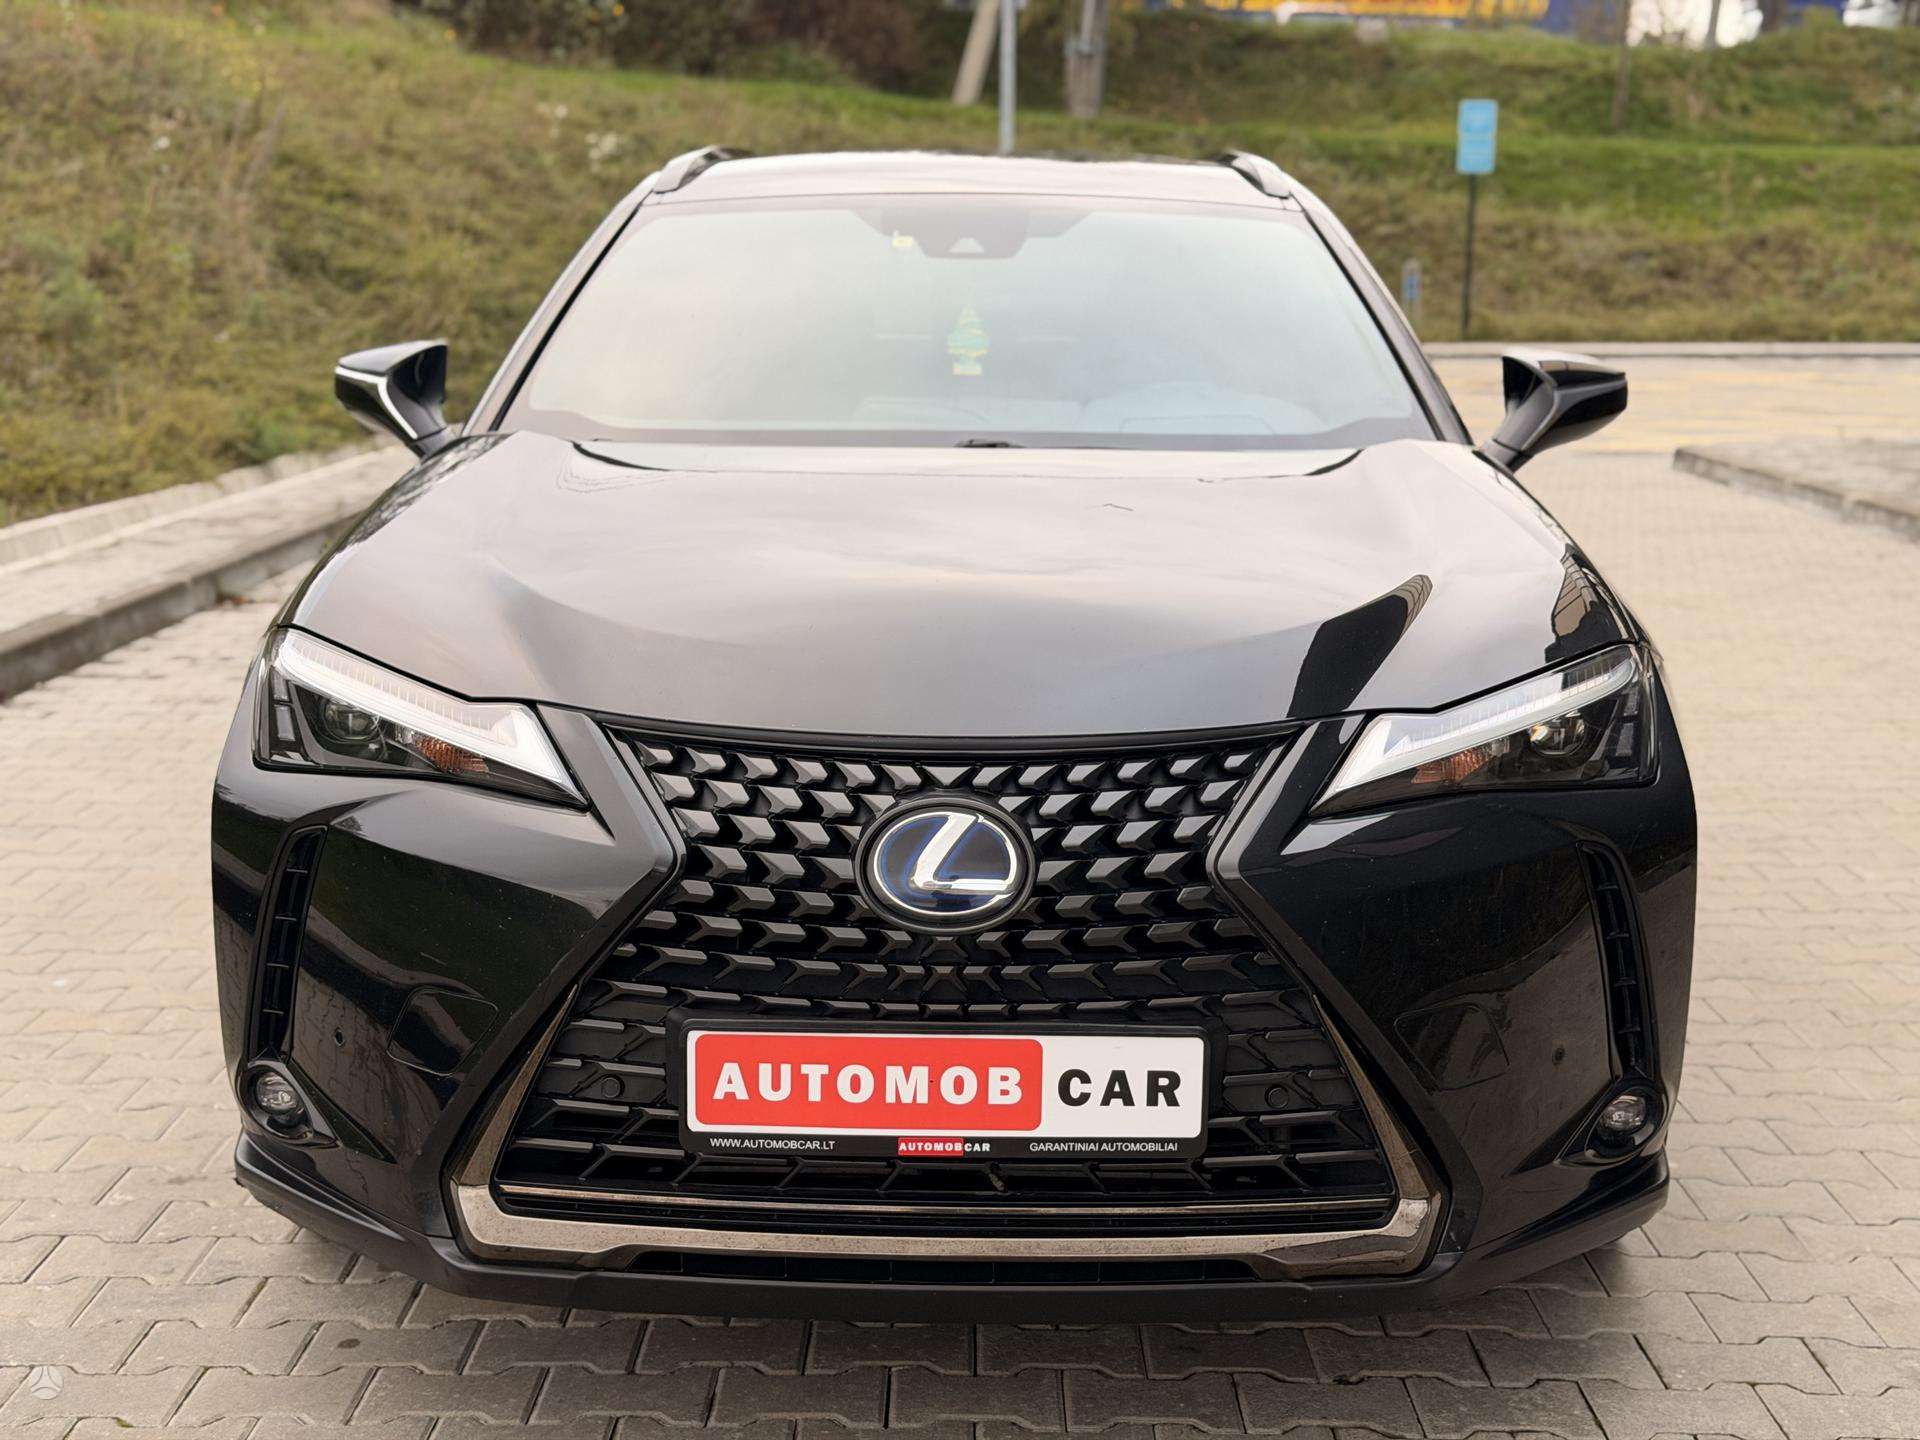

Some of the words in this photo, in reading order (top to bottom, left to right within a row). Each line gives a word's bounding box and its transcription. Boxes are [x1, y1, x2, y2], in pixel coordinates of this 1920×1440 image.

[713, 1062, 1023, 1105] AUTOMOB
[1057, 1069, 1181, 1108] CAR
[709, 1137, 836, 1150] WWW.AUTOMOBCAR.LT
[1029, 1142, 1099, 1152] GARANTINIAI
[1100, 1142, 1178, 1152] AUTOMOBILIAI
